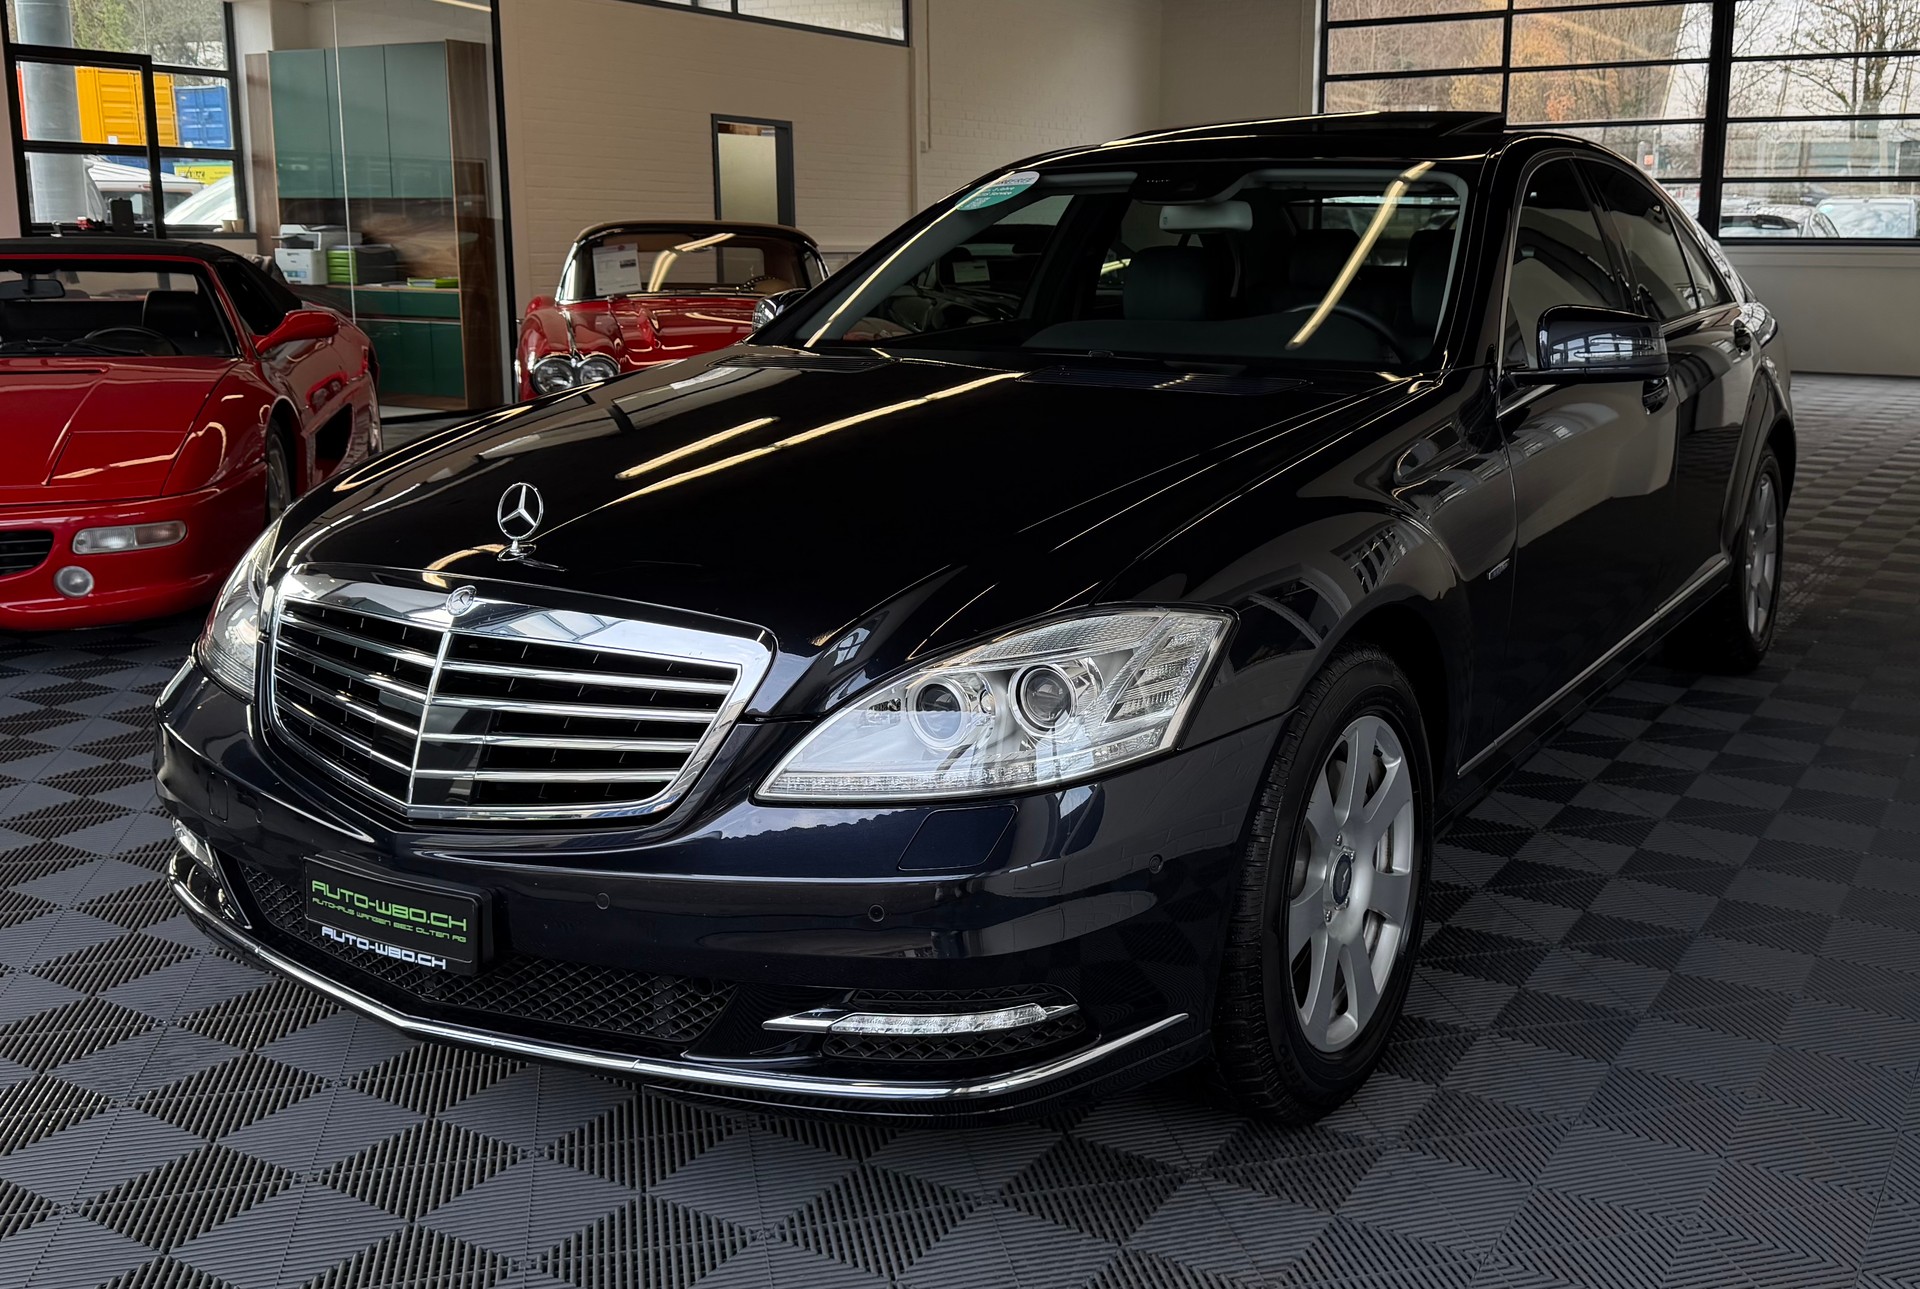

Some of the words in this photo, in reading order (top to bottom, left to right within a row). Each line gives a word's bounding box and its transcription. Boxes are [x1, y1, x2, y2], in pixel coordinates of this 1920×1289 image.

[311, 880, 467, 931] AUTO-WBO.CH
[312, 897, 355, 916] AUTOHAUS
[356, 911, 391, 927] WANGEN
[393, 921, 414, 932] BEI
[415, 926, 450, 940] OLTEN
[452, 934, 467, 943] AG
[321, 925, 447, 970] AUTO-WBO.CH
